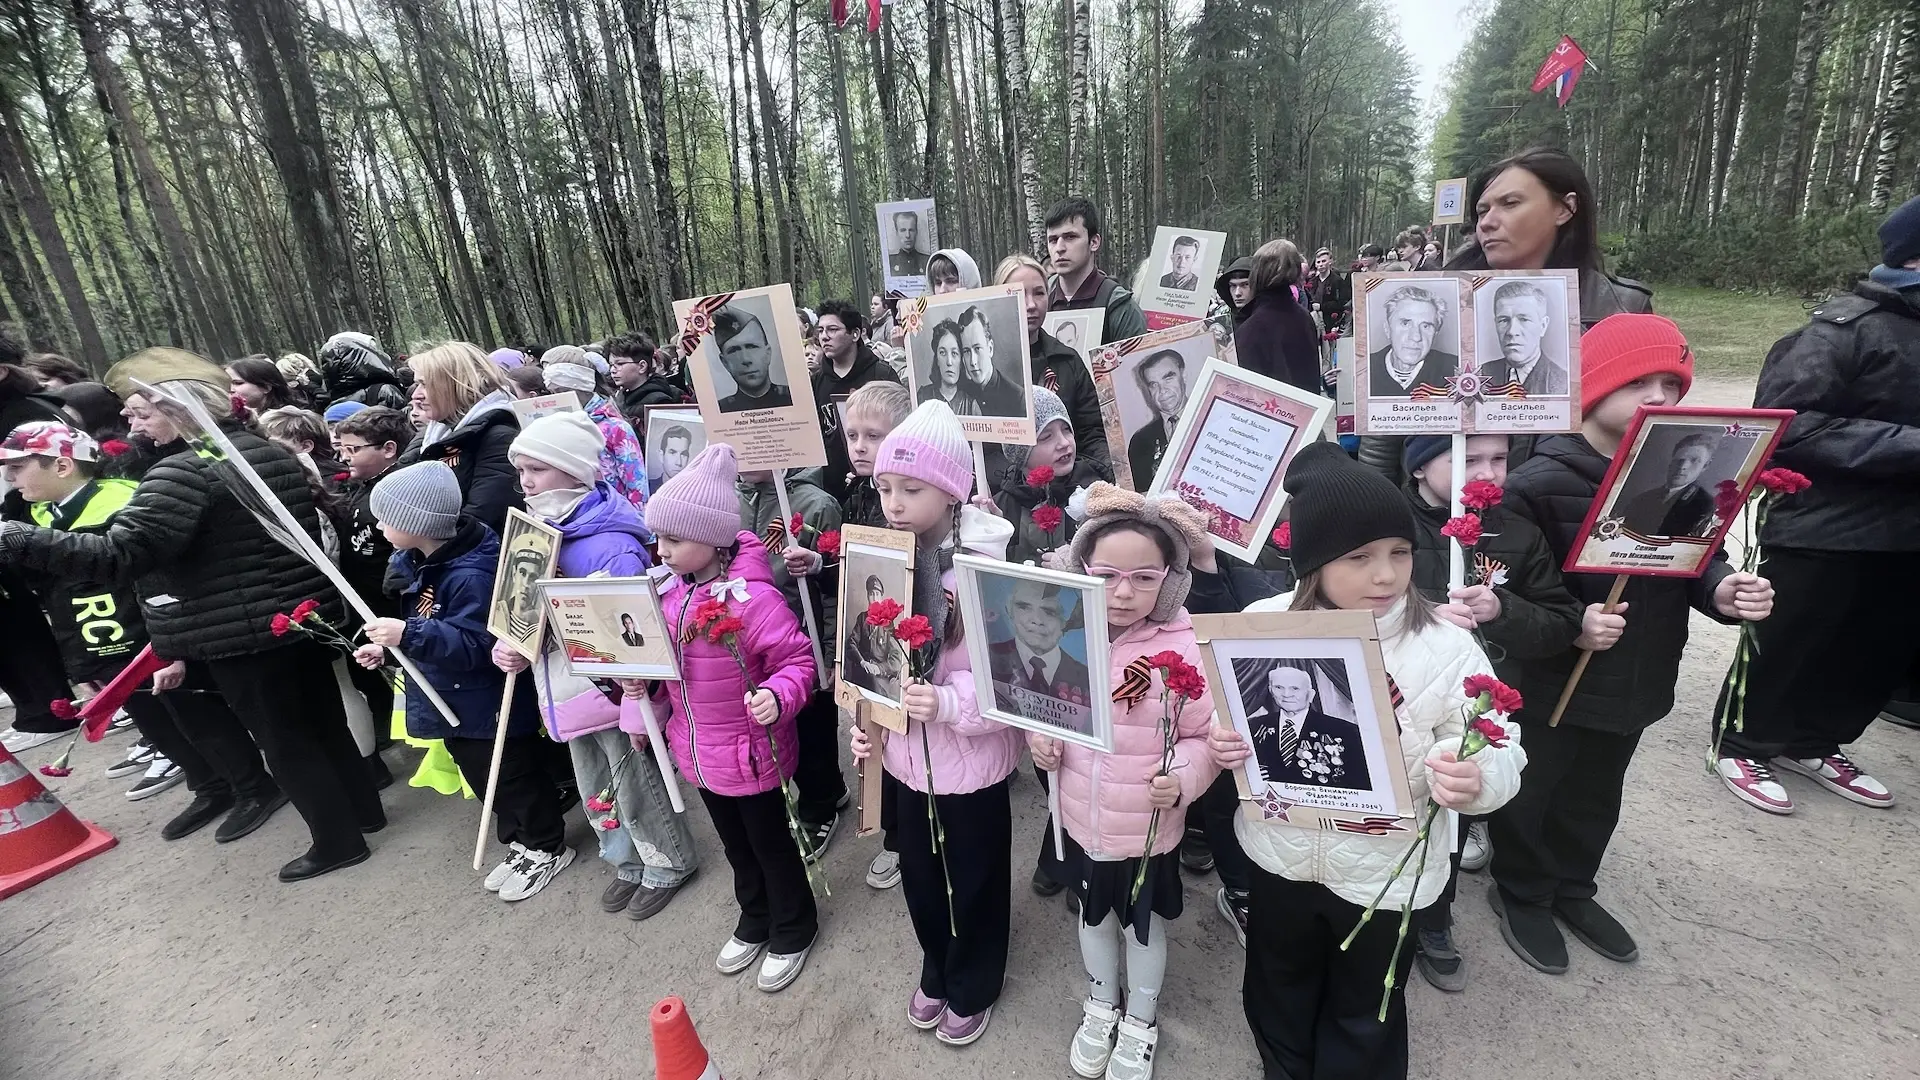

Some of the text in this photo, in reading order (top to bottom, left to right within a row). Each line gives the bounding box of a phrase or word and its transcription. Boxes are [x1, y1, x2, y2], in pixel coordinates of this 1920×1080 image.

[1443, 200, 1454, 209] 62
[1392, 403, 1437, 412] Васильев
[1500, 402, 1546, 412] Васильев
[1370, 414, 1458, 423] Анатолий Сергеевич
[1486, 413, 1560, 423] Сергей Егорович
[72, 593, 124, 644] RC
[1008, 684, 1078, 716] ЮСУПОВ
[1023, 701, 1062, 720] ЭРГАШ
[1284, 783, 1360, 796] Воронов Вениамин
